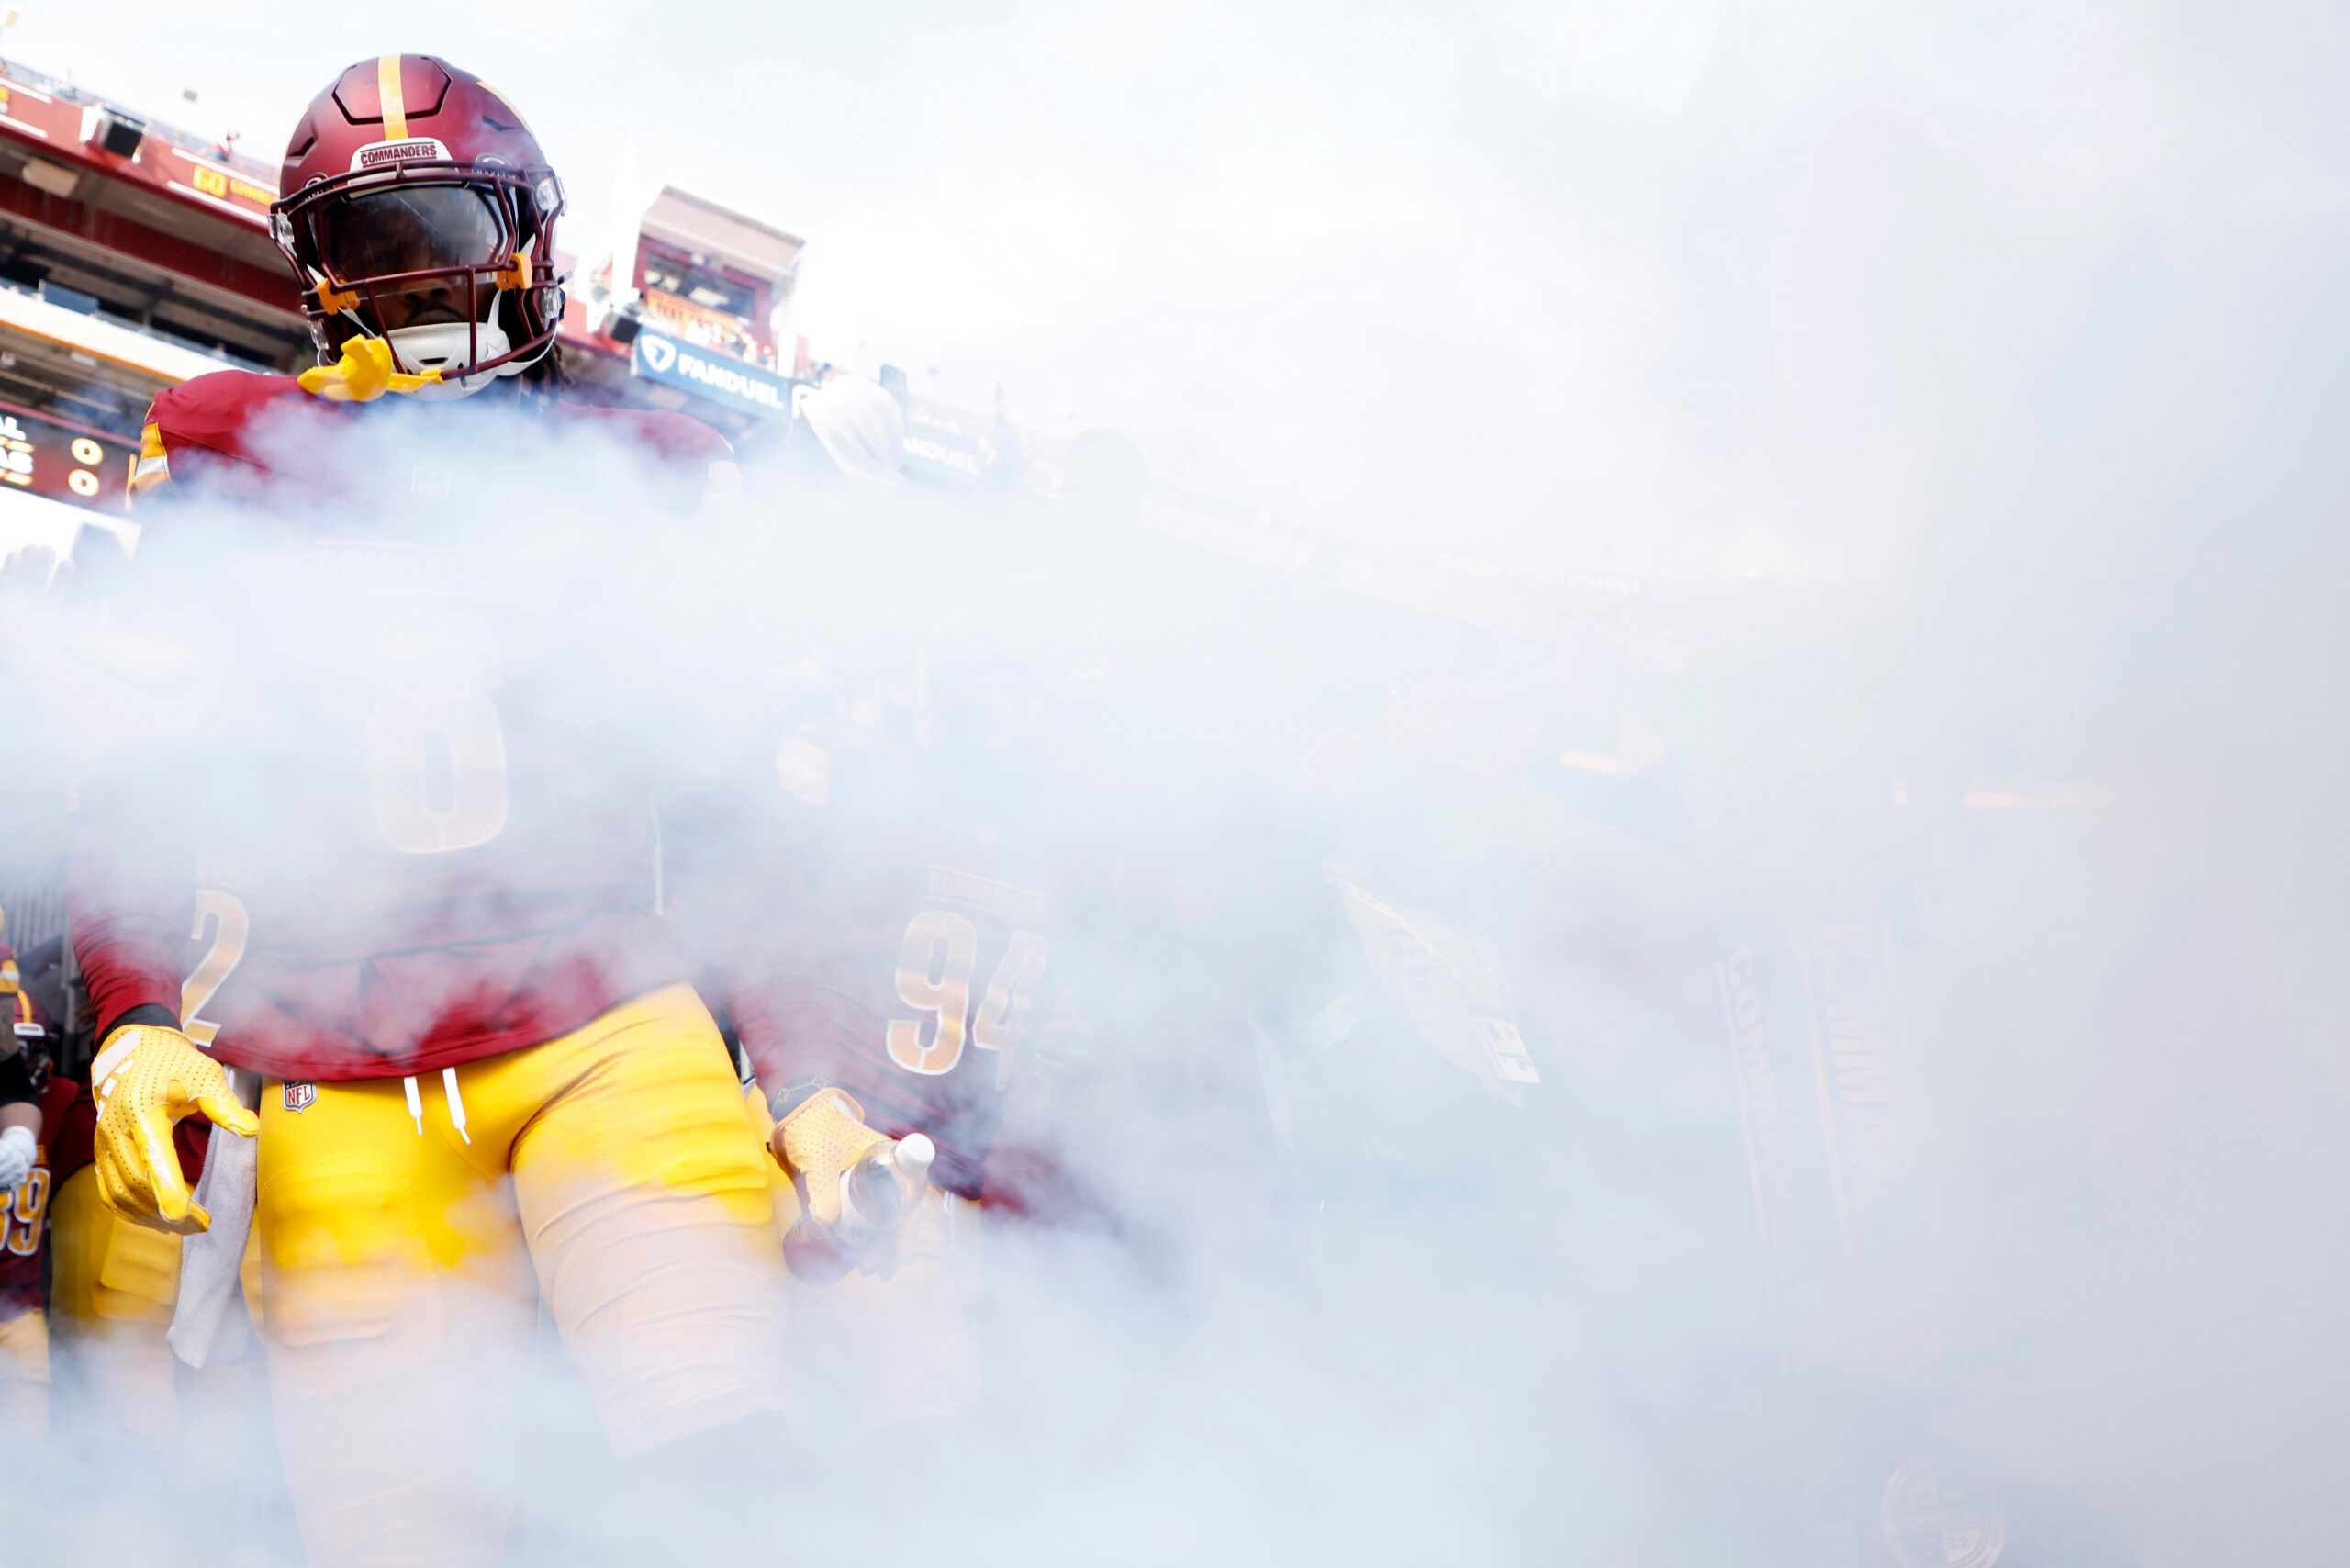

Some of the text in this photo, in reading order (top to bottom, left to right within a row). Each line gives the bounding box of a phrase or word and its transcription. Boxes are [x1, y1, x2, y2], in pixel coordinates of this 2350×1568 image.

[360, 144, 437, 165] COMMANDERS
[678, 353, 785, 409] FANDUEL
[365, 679, 508, 855] 0
[886, 911, 1046, 1091] 94
[287, 1084, 310, 1104] NFL
